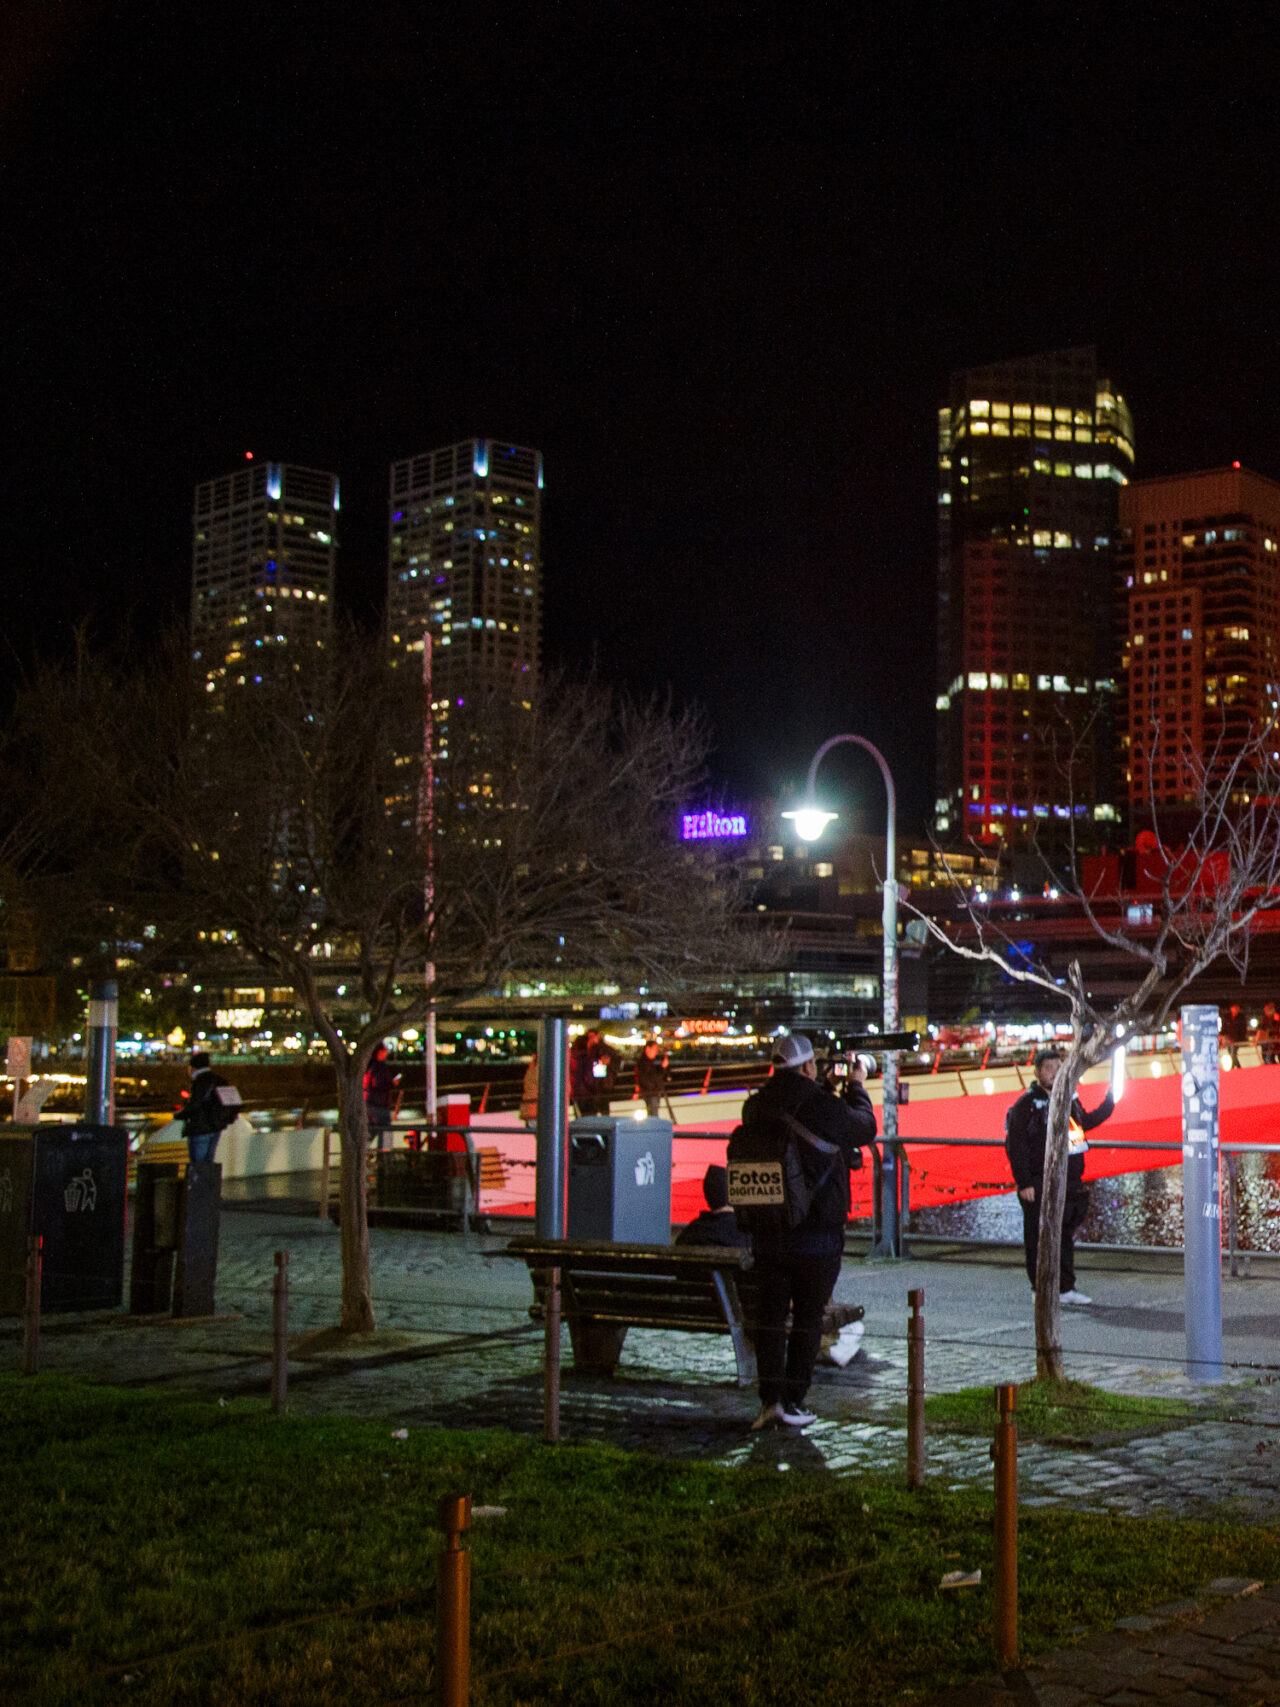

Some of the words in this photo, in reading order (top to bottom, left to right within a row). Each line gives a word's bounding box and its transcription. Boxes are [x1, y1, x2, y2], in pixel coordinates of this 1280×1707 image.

[682, 811, 747, 840] Hilton
[729, 1170, 781, 1185] Fotos
[729, 1185, 782, 1196] DIGITALES
